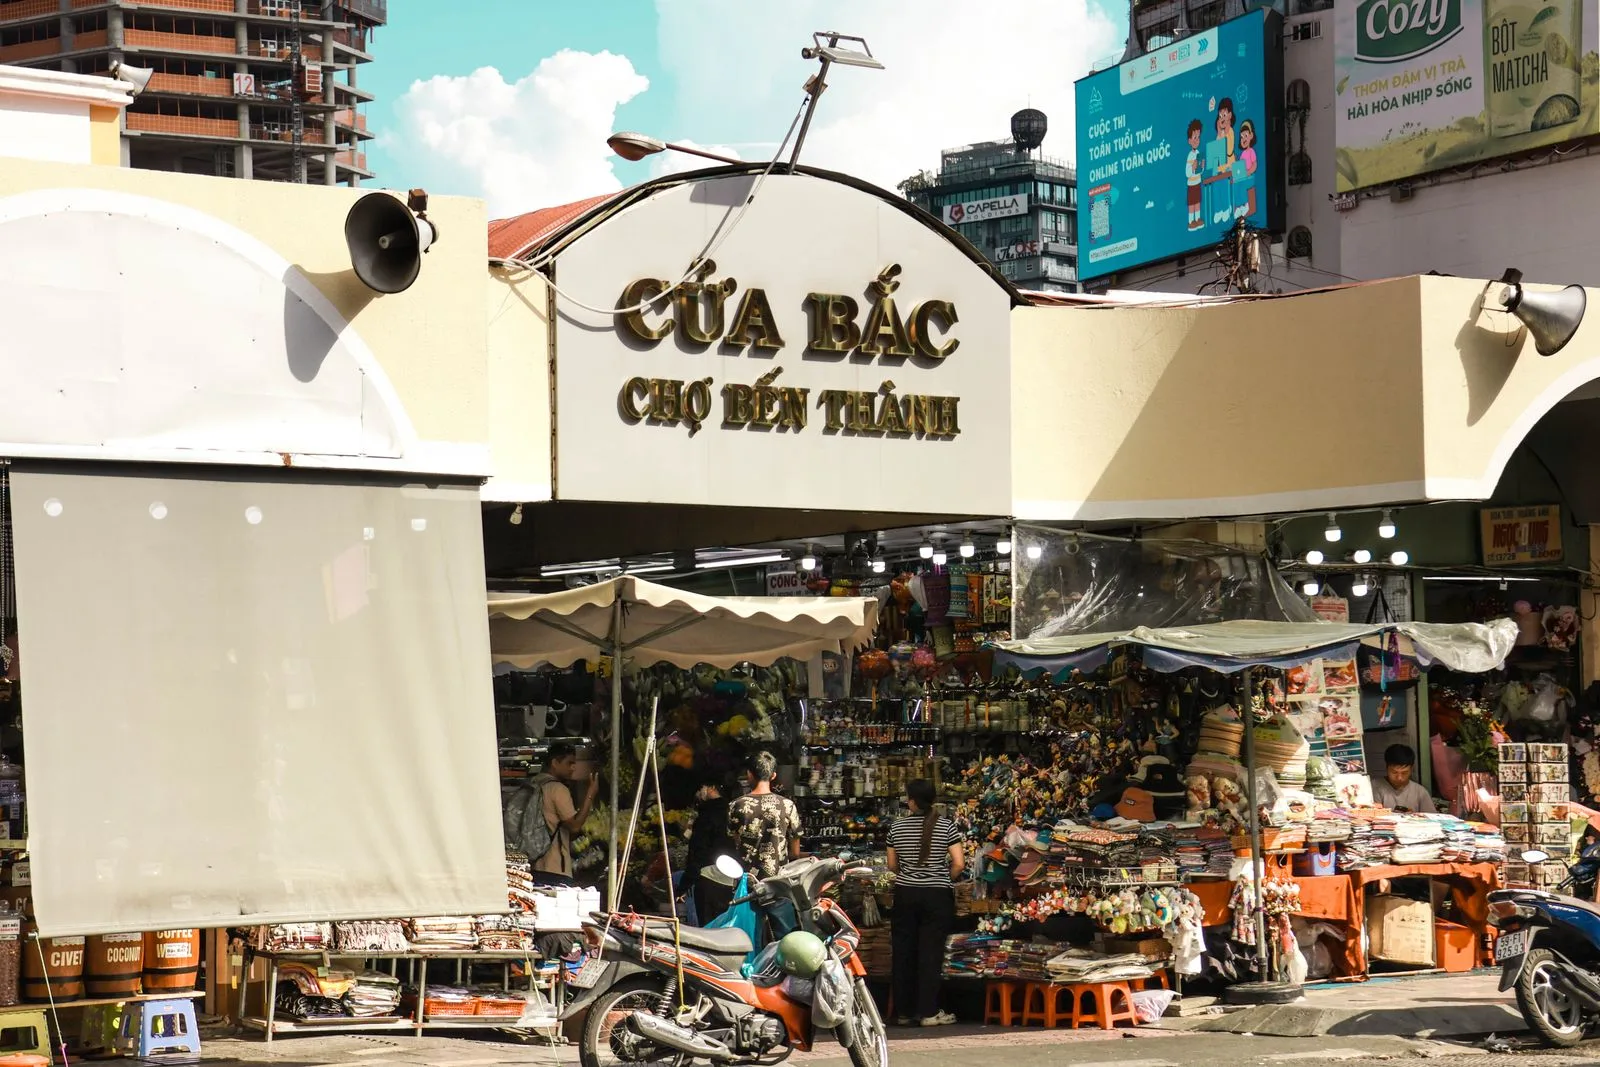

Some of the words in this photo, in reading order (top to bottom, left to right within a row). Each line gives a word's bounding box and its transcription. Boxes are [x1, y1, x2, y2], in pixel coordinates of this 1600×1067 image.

[1366, 0, 1449, 40] Cozy
[1492, 18, 1518, 56] BỘT
[236, 75, 253, 93] 12
[1353, 79, 1388, 97] THƠM
[1392, 71, 1420, 89] ĐẬM
[1424, 63, 1437, 80] VỊ
[1492, 50, 1548, 93] MATCHA
[1347, 102, 1368, 120] HÀI
[1372, 96, 1399, 114] HÒA
[1402, 88, 1432, 105] NHỊP
[1436, 76, 1472, 97] SỐNG
[1089, 118, 1110, 139] CUỘC
[1113, 114, 1126, 130] THI
[1089, 141, 1111, 160] TOÁN
[1136, 125, 1153, 144] THƠ
[1089, 156, 1118, 183] ONLINE
[1121, 152, 1144, 172] TOÀN
[1146, 139, 1171, 163] QUỐC
[966, 198, 1019, 214] CAPELLA
[966, 209, 1019, 220] HOLDINGS
[617, 258, 786, 350] CỬA
[805, 263, 961, 358] BẮC
[621, 376, 714, 436] CHỢ
[722, 366, 811, 429] BẾN
[818, 380, 961, 436] THÀNH
[107, 946, 141, 963] COCONUT
[1500, 933, 1521, 948] 59-F1
[51, 950, 84, 967] CIVET
